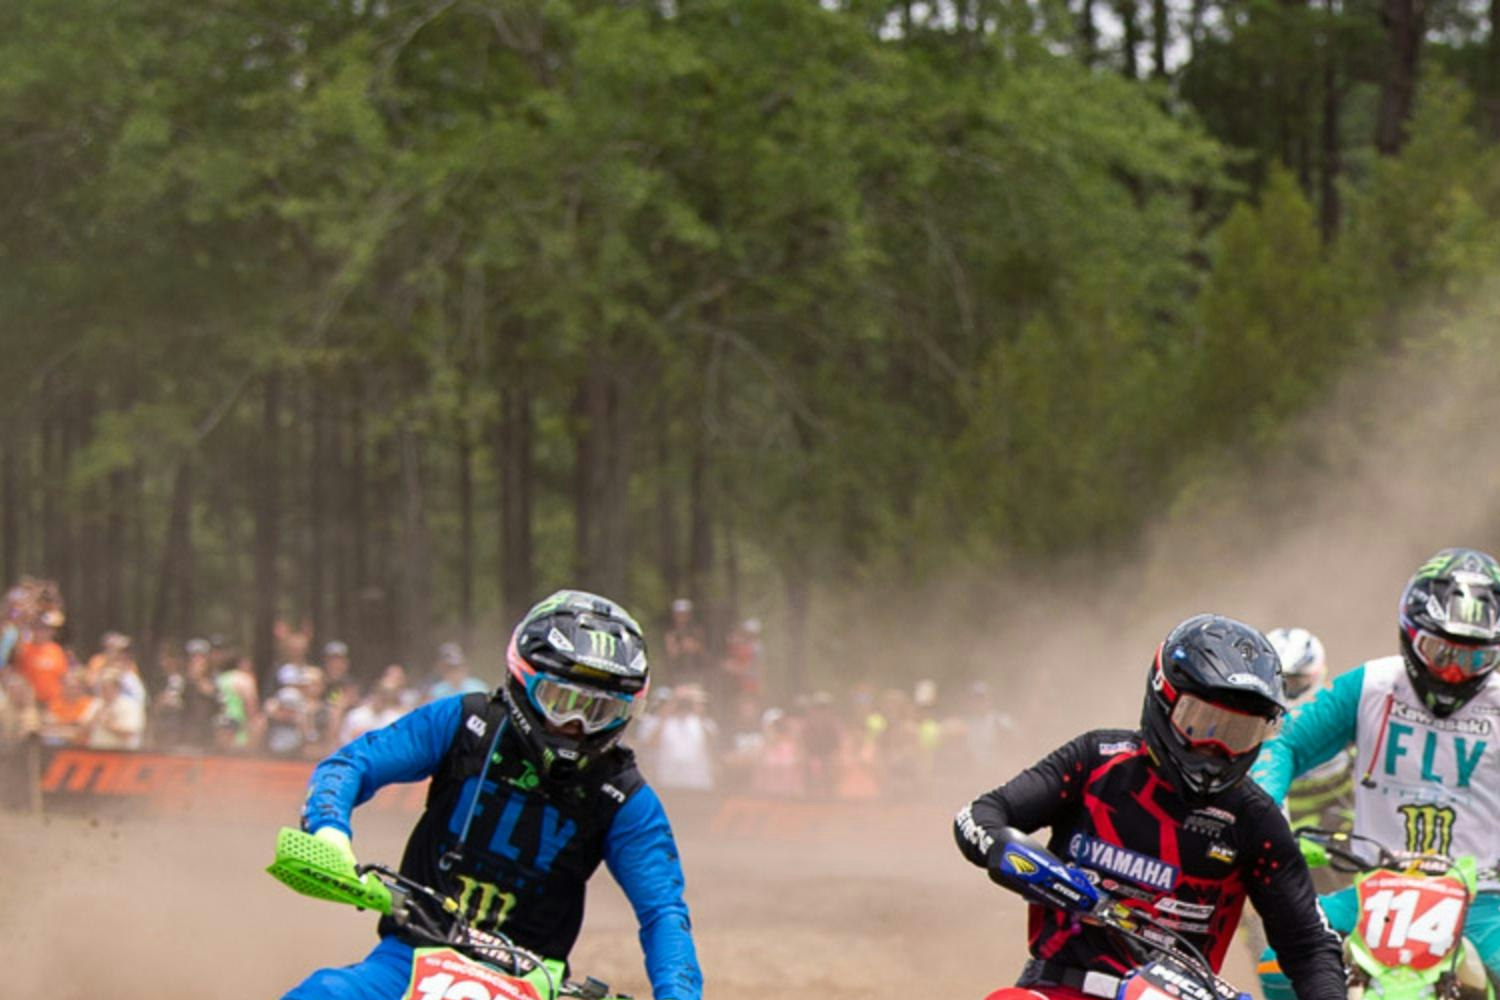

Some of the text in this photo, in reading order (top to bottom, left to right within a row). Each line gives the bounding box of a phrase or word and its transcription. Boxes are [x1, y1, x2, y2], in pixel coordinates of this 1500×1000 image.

[1384, 721, 1488, 788] FLY
[447, 775, 579, 872] FLY
[1090, 841, 1175, 890] YAMAHA
[1363, 889, 1464, 957] 114
